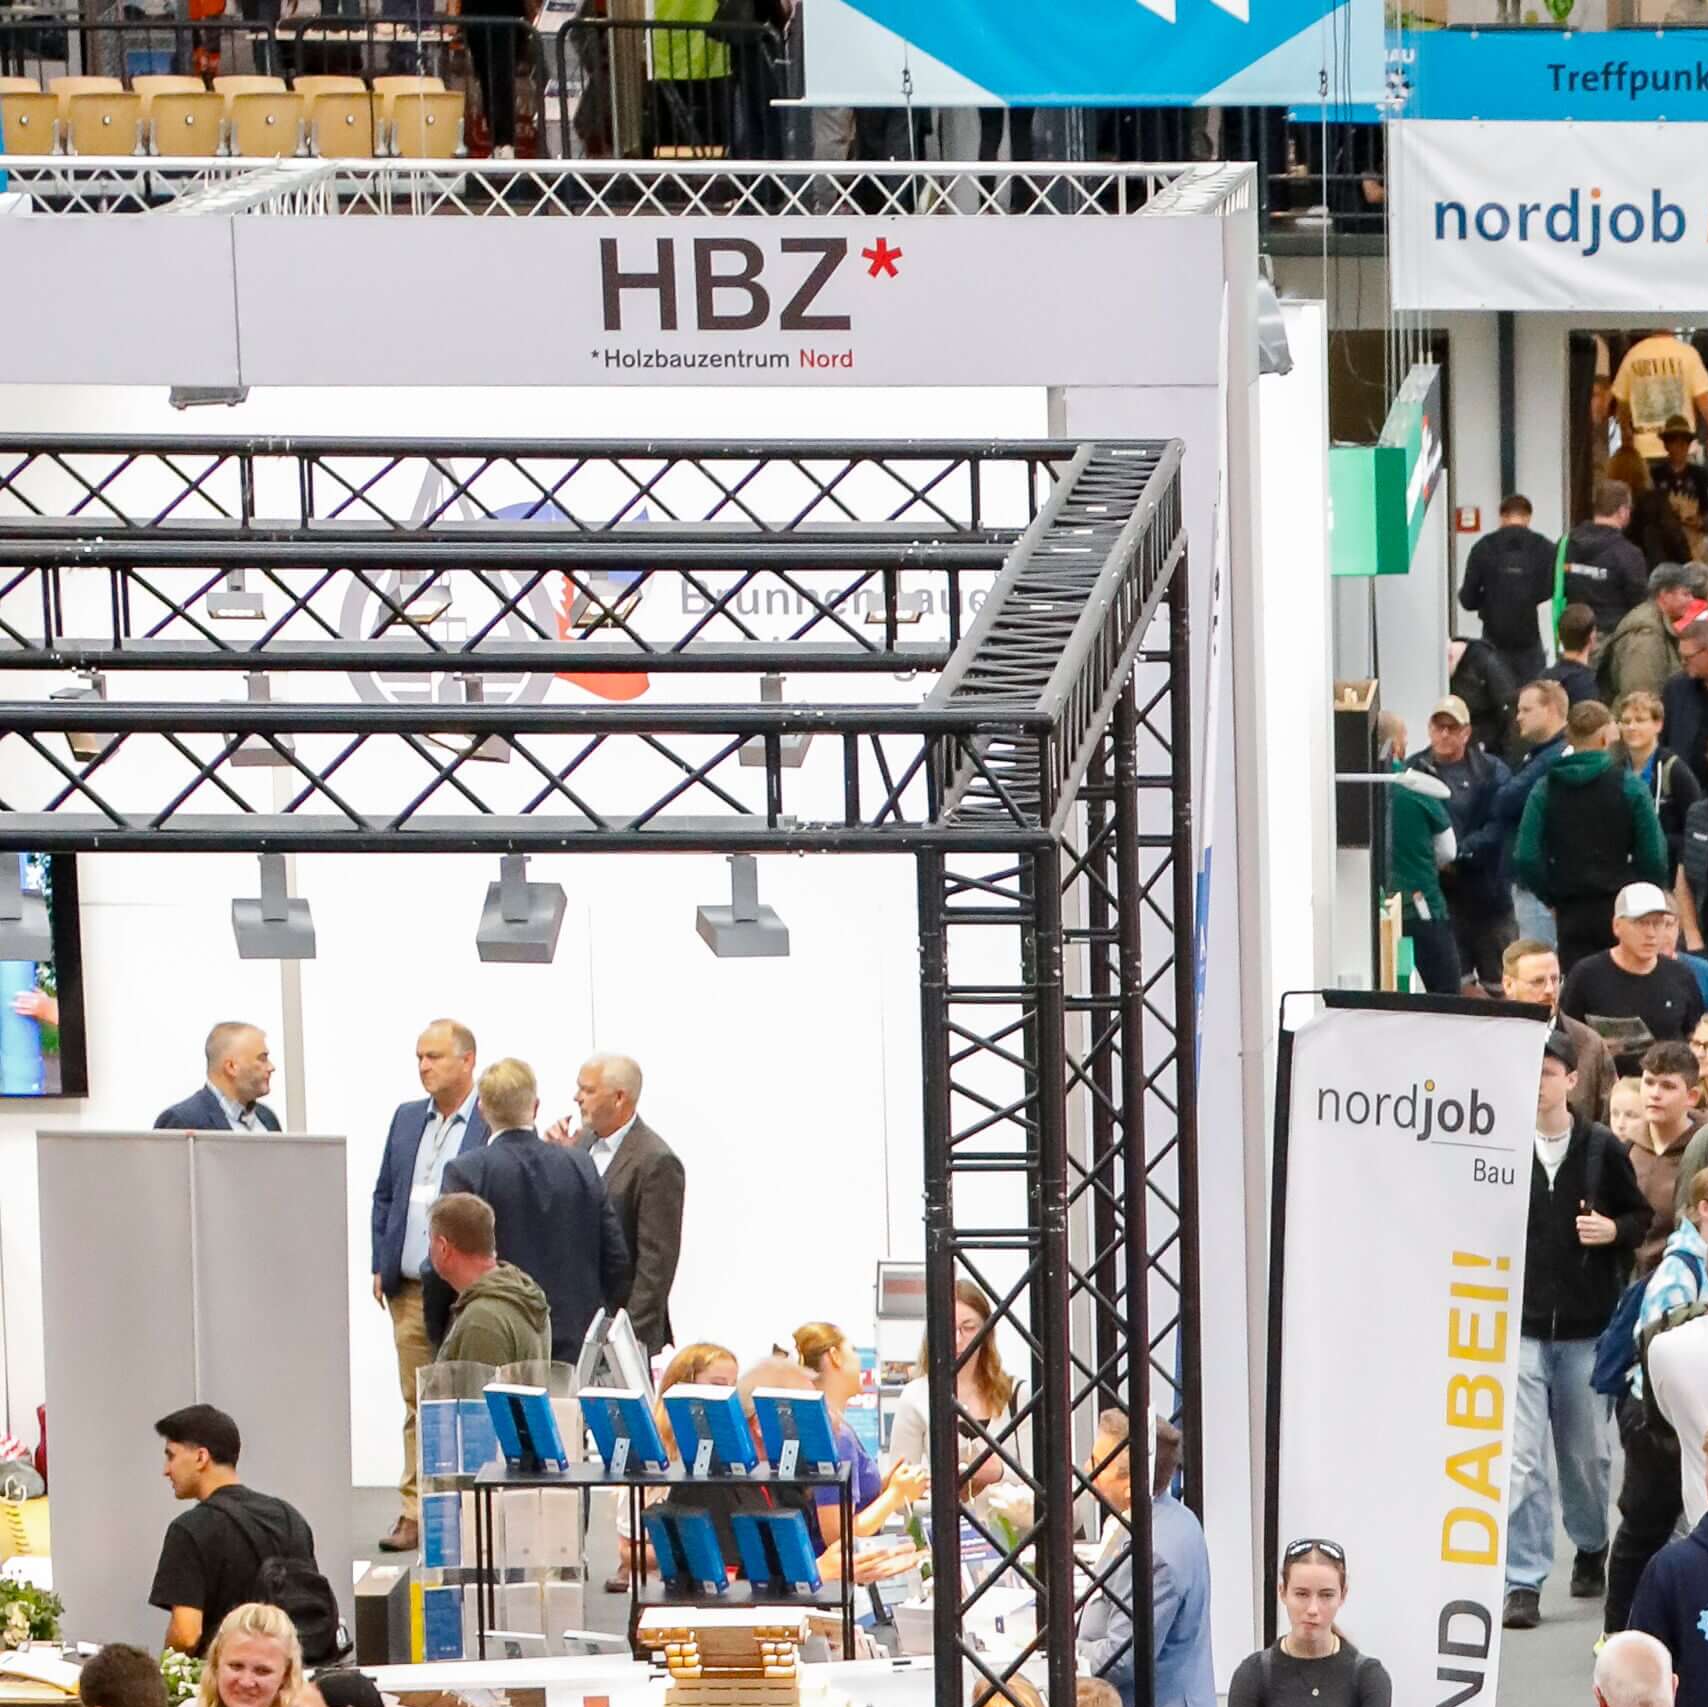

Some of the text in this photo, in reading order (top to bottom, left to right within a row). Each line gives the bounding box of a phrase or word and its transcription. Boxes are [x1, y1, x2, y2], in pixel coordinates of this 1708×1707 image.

[1434, 187, 1687, 257] nordjob
[799, 348, 854, 369] Nord
[1317, 1078, 1496, 1142] nordjob
[1472, 1157, 1515, 1185] Bau
[1440, 1250, 1512, 1566] DABEI!
